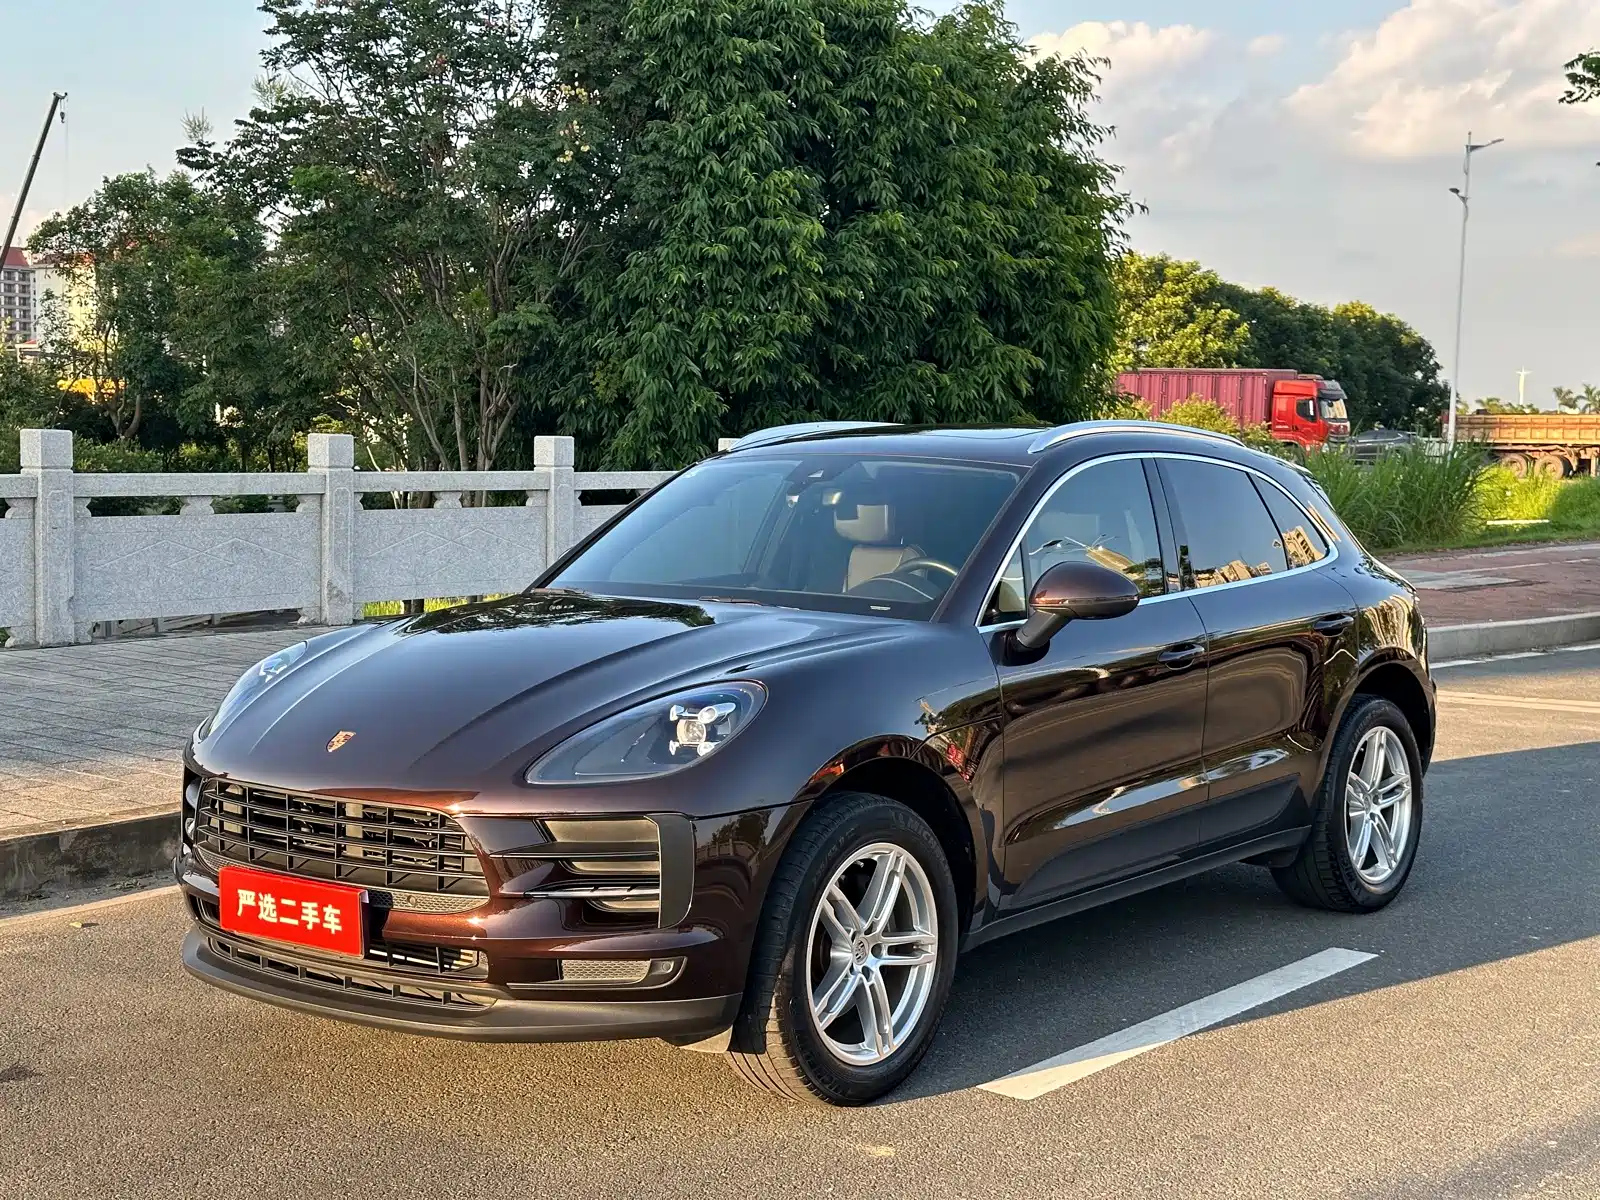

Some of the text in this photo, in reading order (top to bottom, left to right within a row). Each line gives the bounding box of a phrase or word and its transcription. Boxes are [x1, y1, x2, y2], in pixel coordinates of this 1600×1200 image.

[237, 888, 343, 935] 严选二手车
